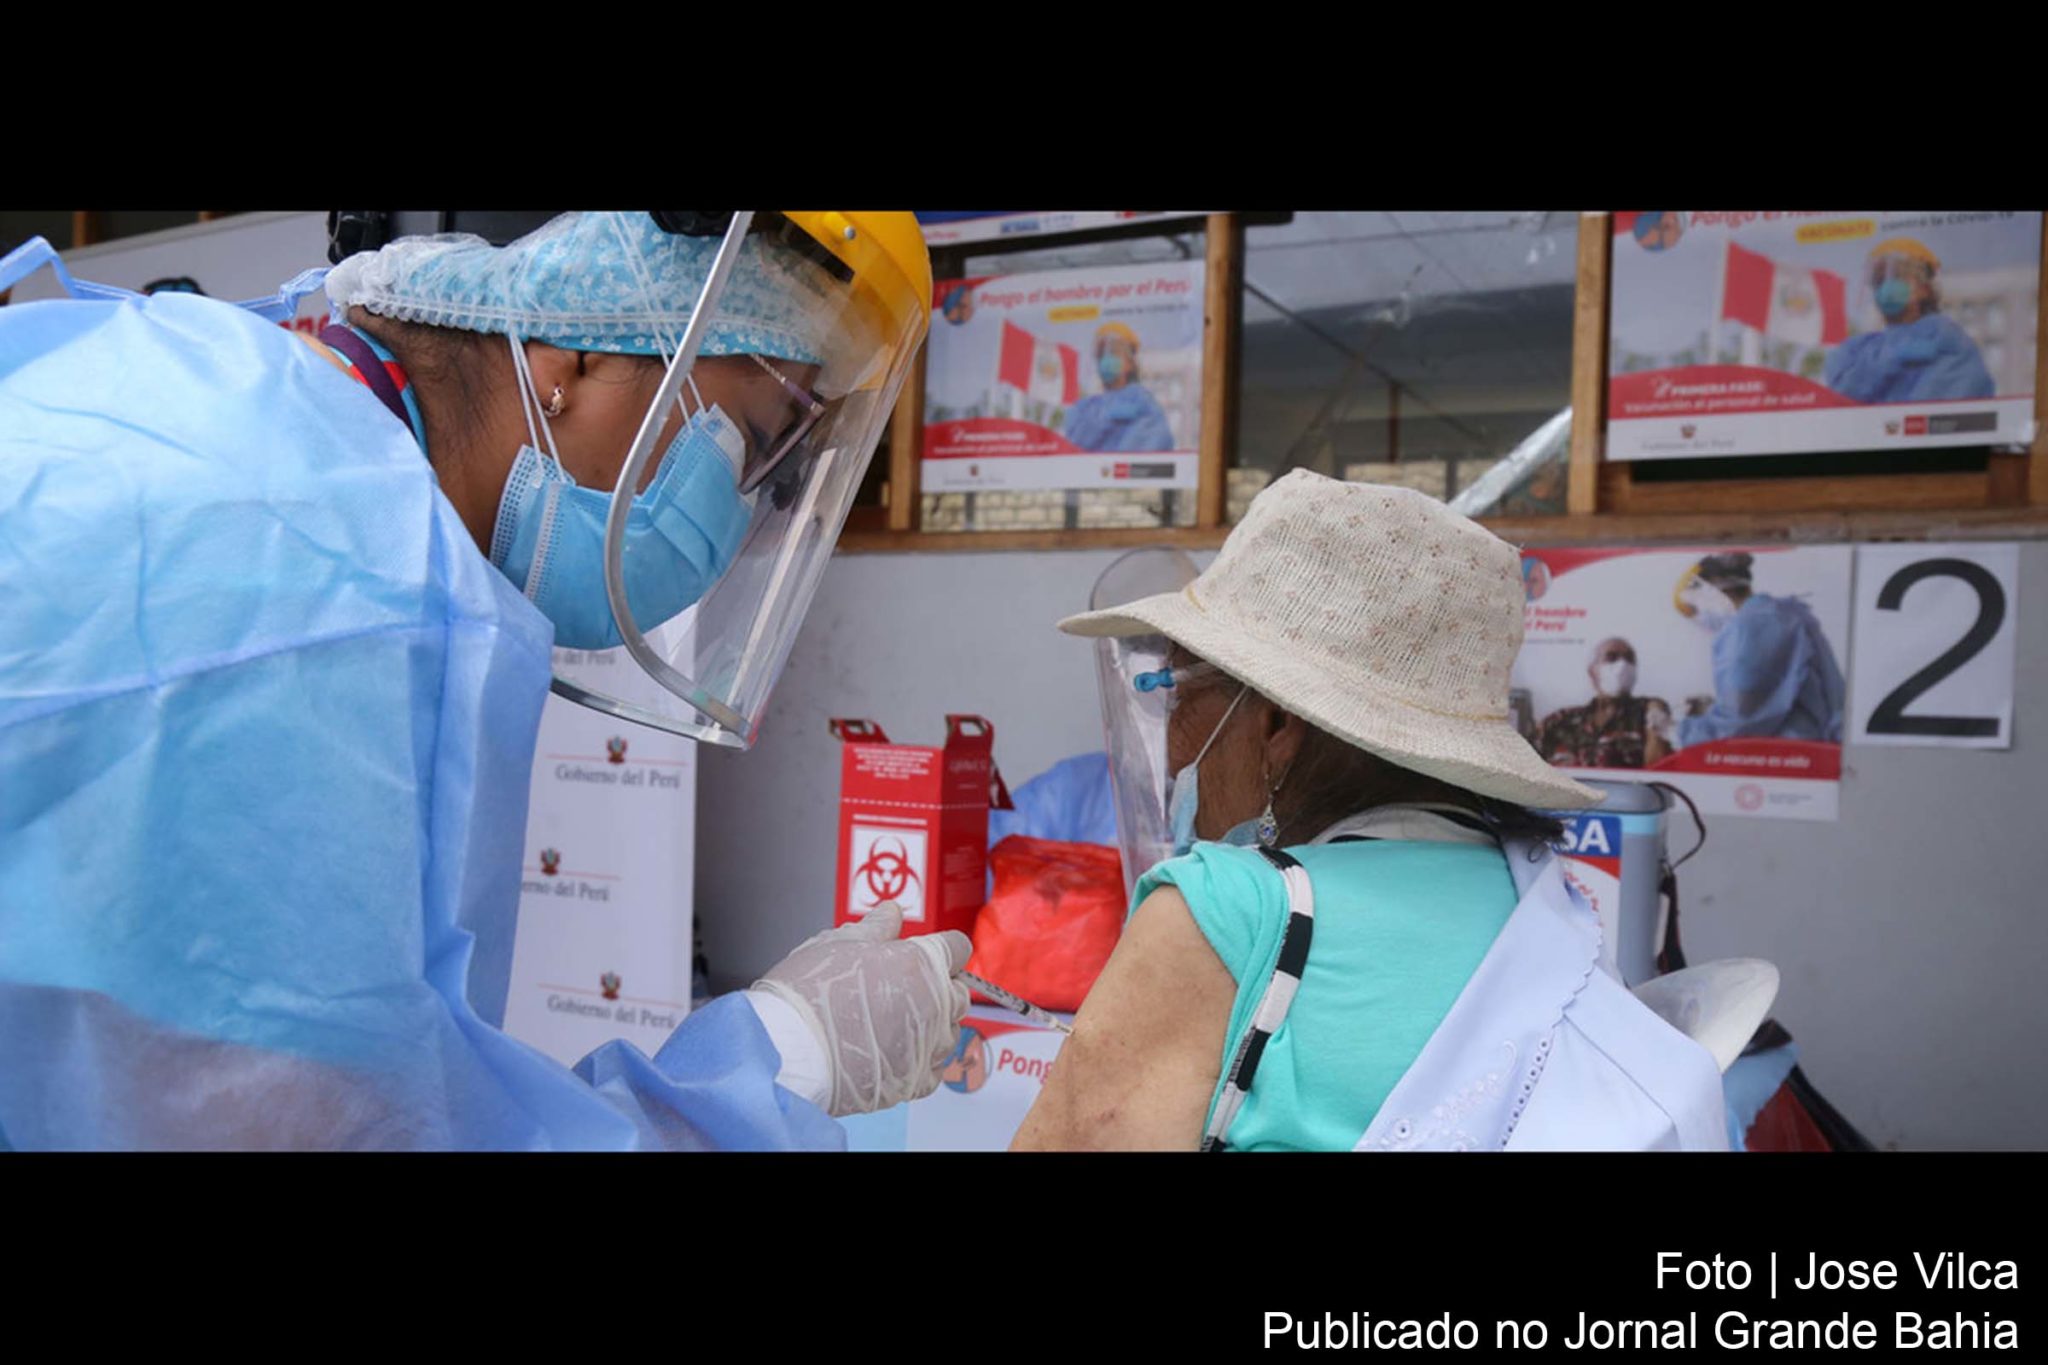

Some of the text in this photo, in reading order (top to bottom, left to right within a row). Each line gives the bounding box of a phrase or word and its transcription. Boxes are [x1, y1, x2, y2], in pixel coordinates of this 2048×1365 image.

[1866, 558, 2006, 737] 2
[554, 764, 680, 789] Gobierno del Perú
[555, 880, 576, 898] del
[580, 881, 610, 902] Perú
[547, 993, 675, 1029] Gobierno del Perú
